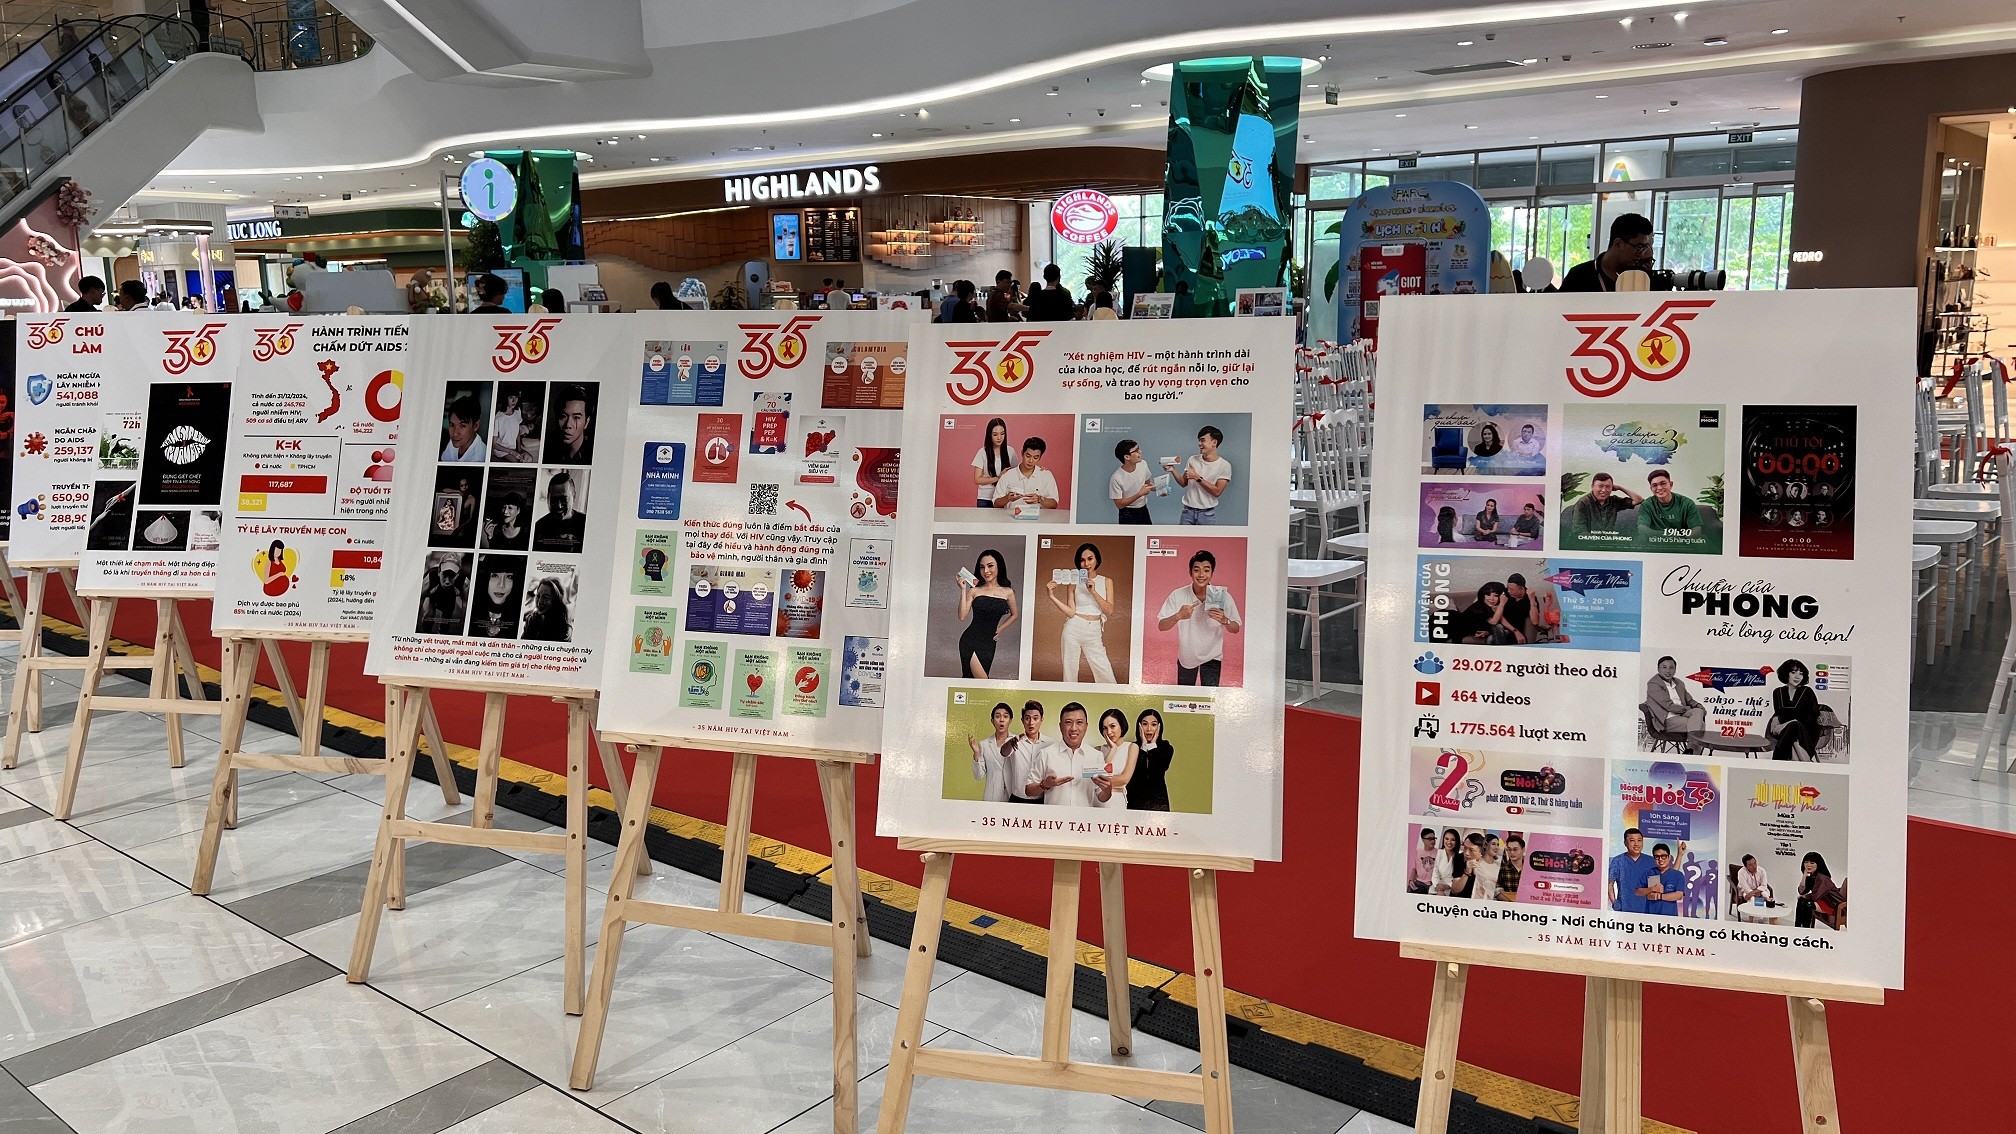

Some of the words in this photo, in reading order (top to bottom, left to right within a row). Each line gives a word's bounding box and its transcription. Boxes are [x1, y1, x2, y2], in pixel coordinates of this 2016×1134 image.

[1730, 134, 1751, 142] EXIT
[724, 166, 880, 202] HIGHLANDS
[1055, 192, 1116, 215] HIGHLANDS
[249, 220, 282, 238] LONG
[1062, 229, 1108, 242] COFFEE
[1793, 250, 1823, 262] PEDRO
[75, 325, 104, 336] CHÚ
[312, 326, 344, 336] HÀNH
[347, 326, 381, 336] TRÌNH
[384, 326, 409, 336] TIẾN
[73, 342, 101, 353] LÀM
[313, 341, 346, 352] CHẤM
[350, 341, 373, 351] DỨT
[375, 343, 402, 351] AIDS
[738, 316, 823, 379] 35
[1562, 300, 1716, 398] 35
[1088, 352, 1124, 362] nghiệm
[1155, 351, 1175, 360] một
[1178, 350, 1203, 358] hành
[1207, 350, 1231, 358] trình
[1235, 350, 1250, 358] dài
[945, 330, 1053, 406] 35
[1059, 365, 1075, 374] của
[1105, 366, 1124, 375] học,
[1128, 364, 1140, 373] để
[1161, 364, 1185, 374] ngắn
[1189, 363, 1204, 372] nỗi
[1208, 364, 1219, 373] lo,
[1223, 364, 1240, 374] giữ
[1243, 363, 1254, 373] lại
[1063, 380, 1075, 389] sự
[1077, 379, 1102, 389] sống,
[1144, 378, 1155, 388] hy
[1158, 380, 1182, 388] vọng
[1210, 379, 1228, 387] vẹn
[57, 392, 98, 400] 541,088
[55, 447, 93, 455] 259,137
[276, 440, 301, 450] K=K
[250, 525, 259, 534] LỆ
[722, 521, 743, 530] đúng
[1662, 528, 1692, 537] 19h30
[1419, 563, 1432, 587] CỦA
[1740, 580, 1775, 594] của
[1432, 563, 1451, 639] PHONG
[1682, 591, 1819, 620] PHONG
[1706, 622, 1734, 637] nỗi
[1738, 621, 1774, 643] lòng
[1778, 628, 1809, 641] của
[1814, 624, 1855, 645] bạn!
[1453, 659, 1502, 672] 29.072
[1506, 664, 1550, 677] người
[1554, 663, 1588, 676] theo
[1592, 665, 1617, 678] dõi
[1451, 690, 1477, 702] 464
[1481, 692, 1530, 705] videos
[1704, 696, 1734, 705] 20h30
[1746, 697, 1764, 707] thứ
[1713, 707, 1737, 716] hàng
[1740, 708, 1762, 716] tuần
[1451, 723, 1515, 737] 1.775.564
[1519, 725, 1549, 741] lượt
[1553, 731, 1586, 741] xem
[1720, 726, 1747, 738] 22/3
[1500, 795, 1517, 804] 20h30
[982, 817, 995, 826] 35
[1002, 818, 1032, 828] NĂM
[1039, 820, 1063, 830] HIV
[1069, 822, 1091, 833] TẠI
[1098, 824, 1129, 835] VIỆT
[1136, 826, 1166, 836] NAM
[1417, 903, 1468, 917] Chuyện
[1473, 907, 1497, 919] của
[1502, 910, 1547, 925] Phong
[1562, 916, 1584, 926] Nơi
[1589, 918, 1634, 933] chúng
[1639, 923, 1652, 933] ta
[1658, 924, 1704, 939] không
[1710, 929, 1726, 939] có
[1732, 931, 1788, 947] khoảng
[1793, 937, 1833, 949] cách.
[1556, 936, 1583, 945] NĂM
[1617, 941, 1636, 951] TẠI
[1643, 944, 1671, 954] VIỆT
[1677, 947, 1705, 956] NAM
